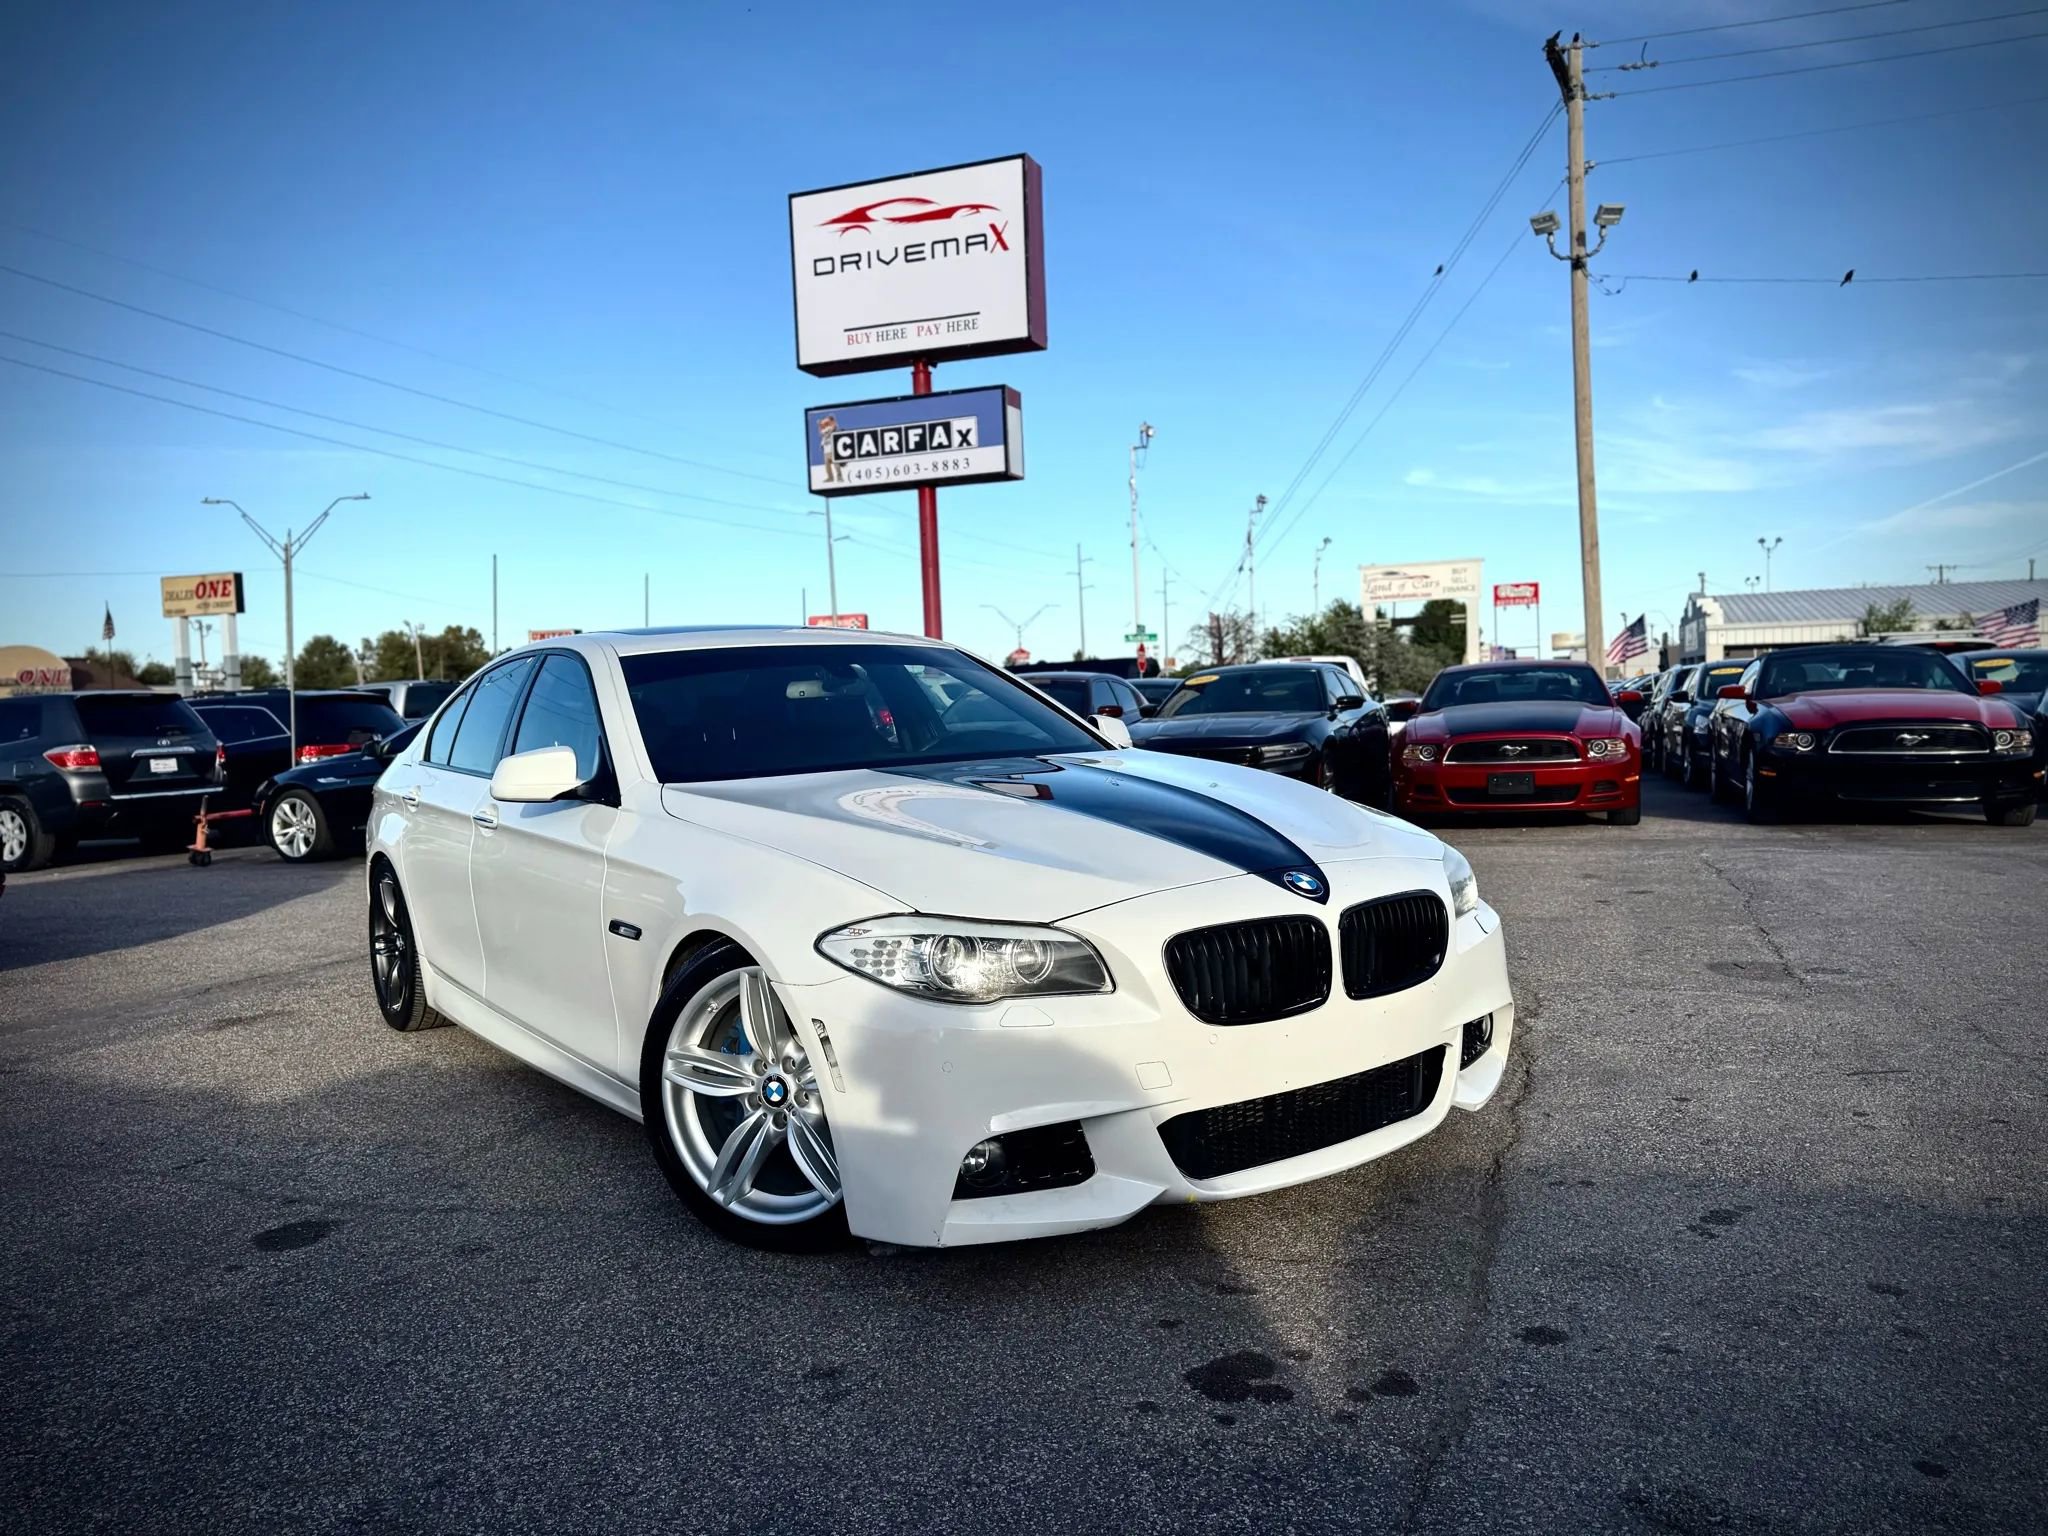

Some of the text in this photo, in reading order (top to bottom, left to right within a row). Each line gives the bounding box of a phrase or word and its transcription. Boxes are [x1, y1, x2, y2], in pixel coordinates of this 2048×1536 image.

[813, 220, 1010, 276] DRIVEMAX
[847, 318, 979, 346] BUY HERE PAY HERE
[836, 425, 973, 458] CARFAX
[847, 457, 971, 483] (405)603-8883
[195, 579, 232, 600] ONE
[1364, 581, 1393, 594] Land
[1411, 579, 1441, 590] Cars
